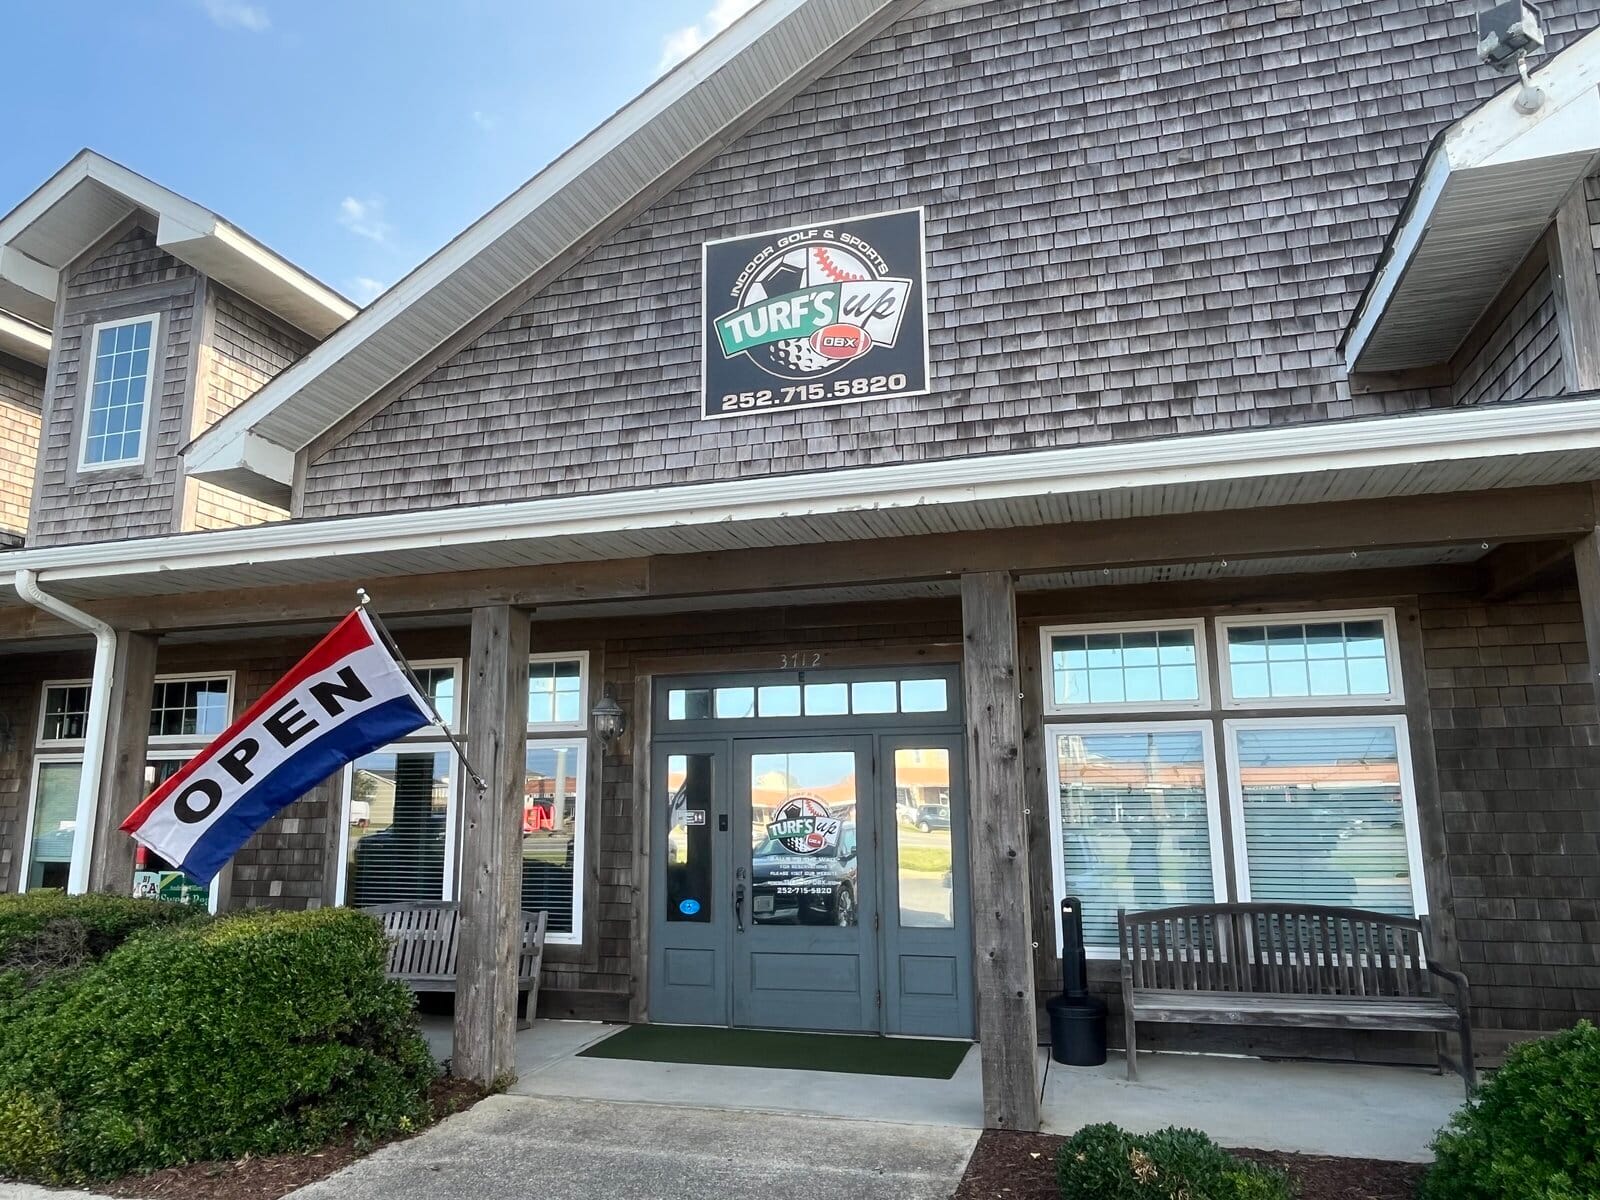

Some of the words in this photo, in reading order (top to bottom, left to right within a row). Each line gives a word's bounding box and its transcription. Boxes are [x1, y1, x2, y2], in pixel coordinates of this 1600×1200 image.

[731, 246, 774, 297] INDOOR
[777, 230, 818, 248] GOLF
[823, 230, 835, 239] &
[840, 233, 889, 275] SPORTS
[724, 290, 835, 344] TURF'S
[843, 288, 896, 329] up
[823, 336, 858, 348] OBX
[722, 374, 907, 411] 252.715.5820
[174, 665, 373, 824] OPEN
[769, 818, 813, 836] TURF'S
